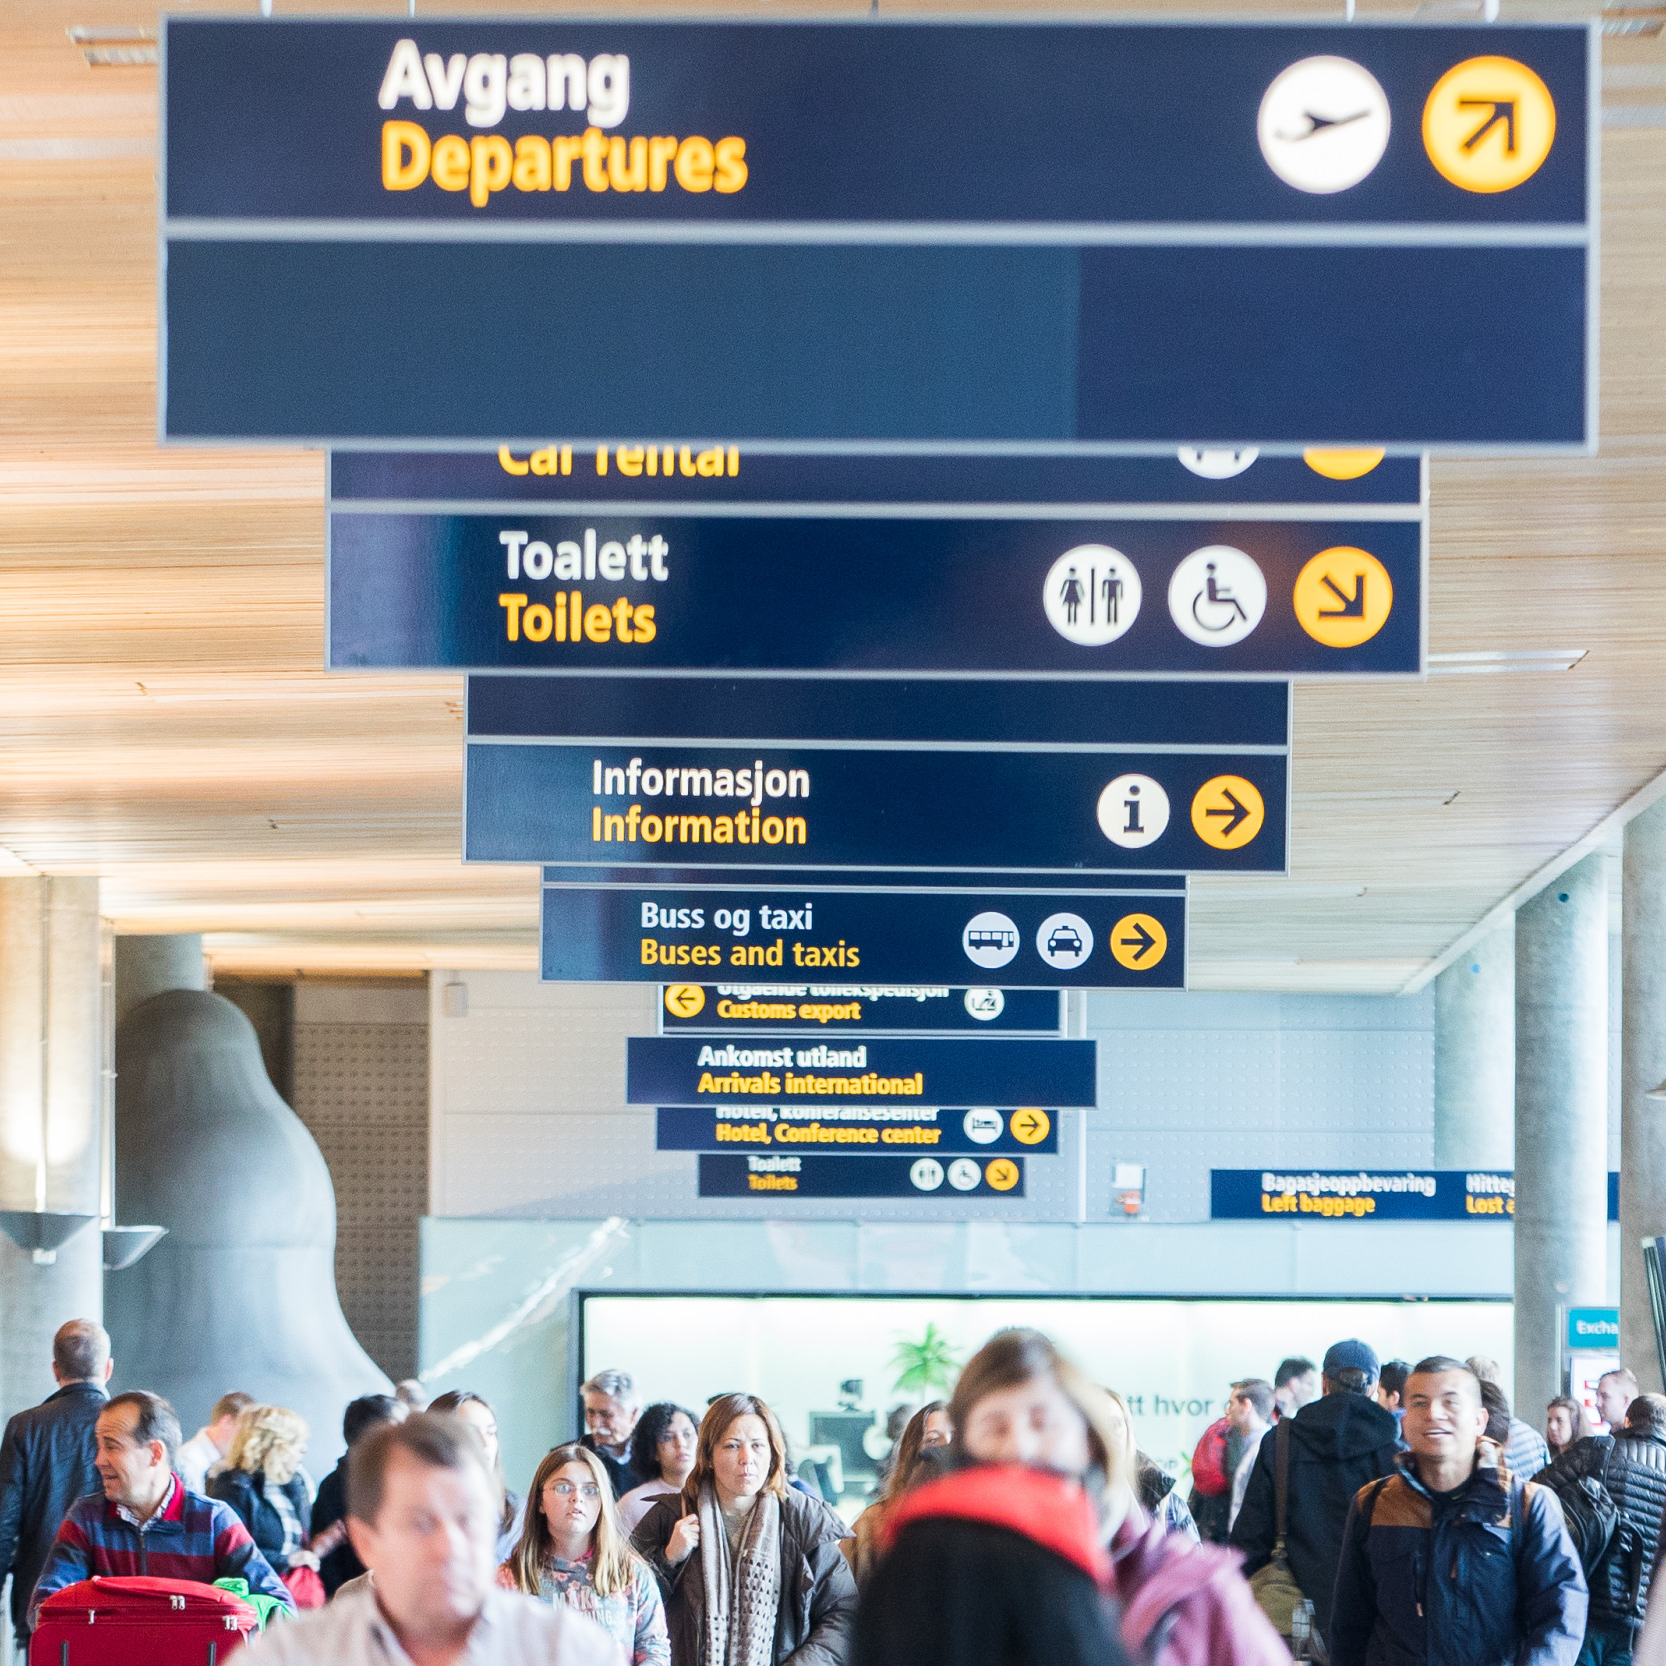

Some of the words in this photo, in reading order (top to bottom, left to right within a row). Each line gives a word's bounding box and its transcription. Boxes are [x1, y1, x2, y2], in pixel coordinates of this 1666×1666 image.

[378, 38, 630, 128] Avgang
[381, 120, 749, 208] Departures
[499, 528, 669, 581] Toalett
[499, 590, 656, 644] Toilets
[592, 757, 811, 807] Informasjon
[592, 804, 807, 844] Information
[641, 901, 705, 929] Buss
[714, 906, 750, 936] og
[759, 902, 813, 930] taxi
[641, 938, 721, 966] Buses
[730, 939, 783, 967] and
[792, 939, 861, 968] taxis
[717, 1000, 796, 1019] Customs
[798, 1002, 861, 1024] export
[697, 1044, 794, 1068] Ankomst
[797, 1045, 867, 1068] utland
[697, 1071, 781, 1094] Arrivals
[785, 1072, 923, 1095] international
[715, 1122, 772, 1144] Hotel,
[774, 1122, 878, 1143] Conference
[881, 1126, 941, 1144] center
[747, 1155, 802, 1172] Toalett
[747, 1174, 798, 1191] Toilets
[1262, 1172, 1436, 1197] Bagasjeoppbevaring
[1262, 1193, 1298, 1213] Left
[1299, 1192, 1376, 1217] baggage
[1466, 1194, 1504, 1214] Lost
[1576, 1320, 1619, 1335] Excha
[1155, 1393, 1213, 1416] hvor
